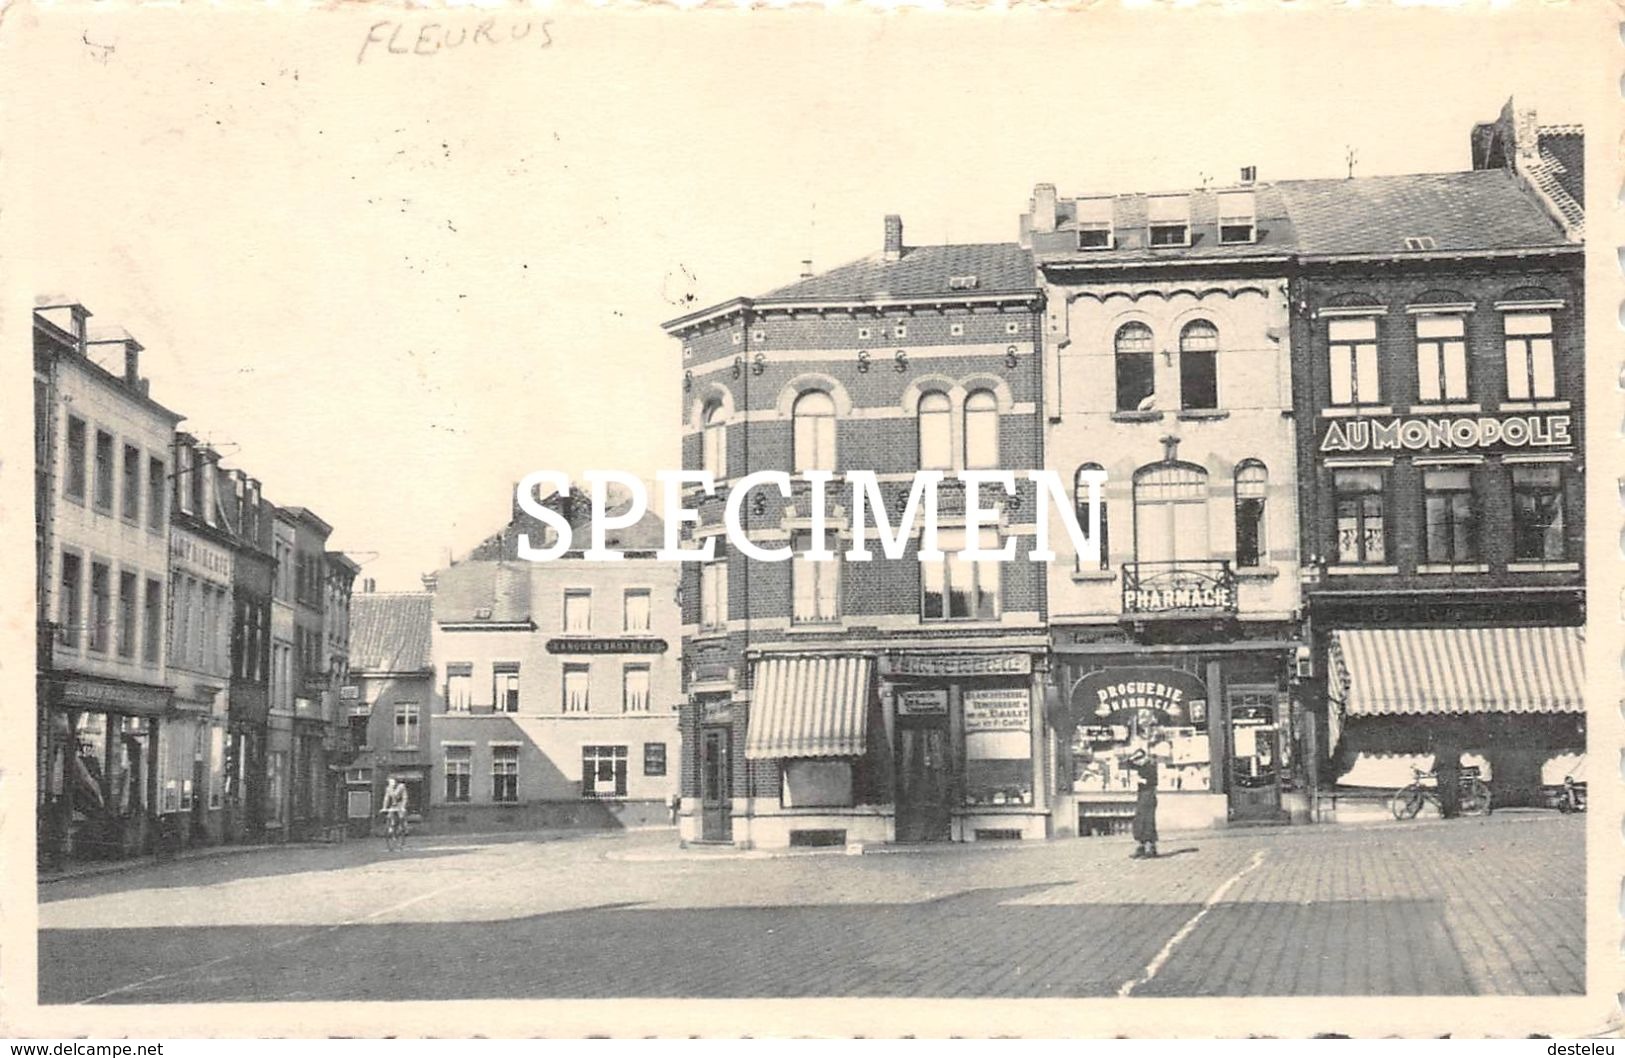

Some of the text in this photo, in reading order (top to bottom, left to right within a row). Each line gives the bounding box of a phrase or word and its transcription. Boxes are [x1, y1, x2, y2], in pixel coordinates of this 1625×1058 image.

[358, 18, 556, 64] FLEURUS
[1321, 416, 1571, 451] AU MONOPOLE
[1124, 588, 1231, 609] PHARMACIE
[1097, 682, 1183, 702] DROGUERIE
